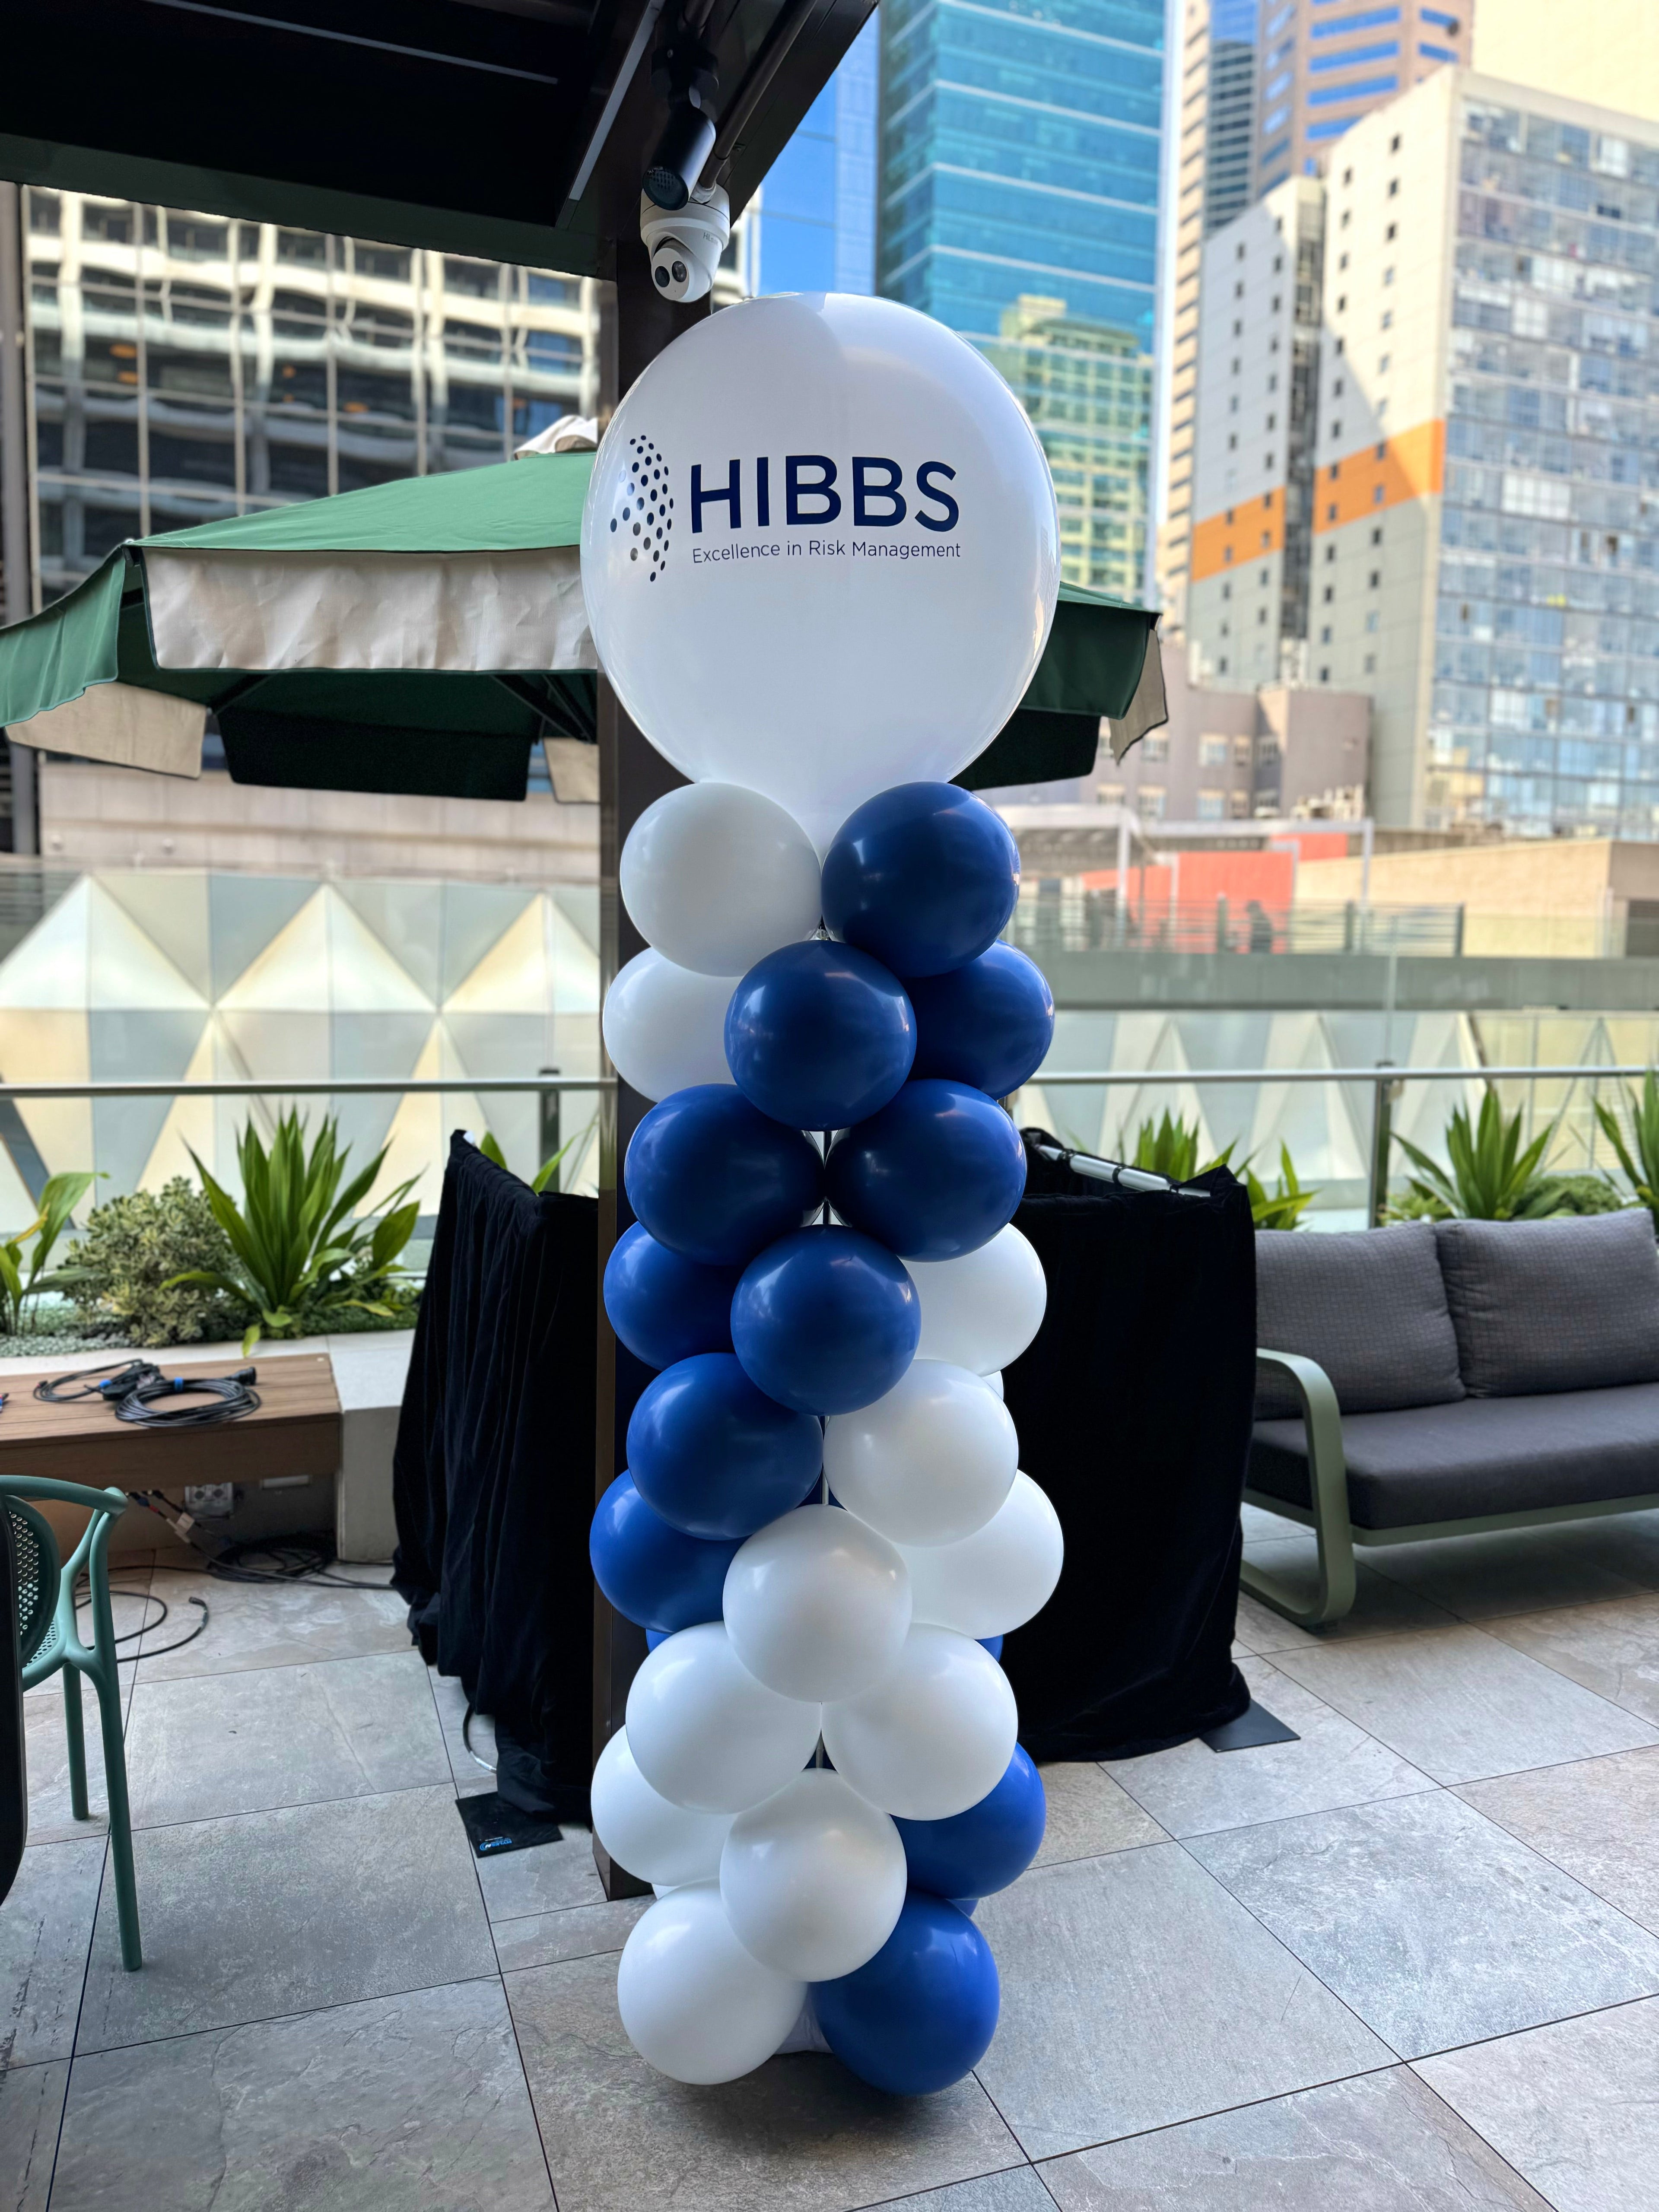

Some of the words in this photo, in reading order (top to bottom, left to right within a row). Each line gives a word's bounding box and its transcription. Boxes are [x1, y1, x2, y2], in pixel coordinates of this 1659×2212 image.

[691, 454, 959, 534] HIBBS
[693, 540, 780, 563] Excellence
[787, 540, 802, 556] in
[809, 540, 846, 556] Risk
[852, 541, 961, 560] Management
